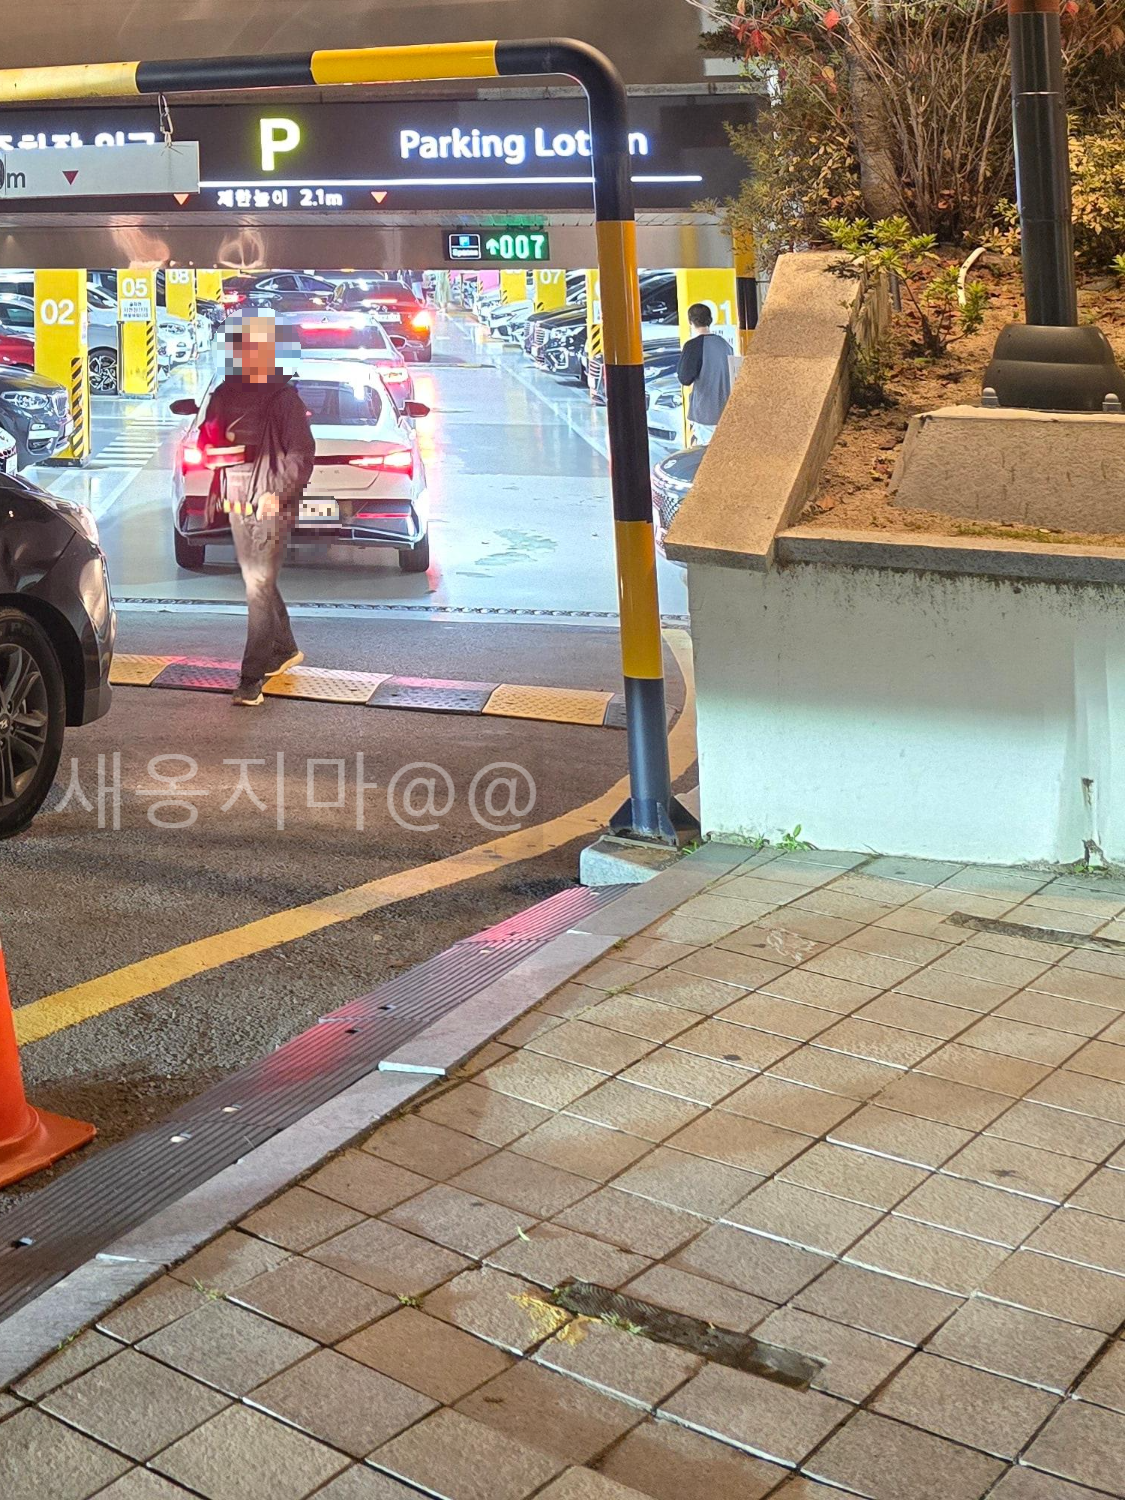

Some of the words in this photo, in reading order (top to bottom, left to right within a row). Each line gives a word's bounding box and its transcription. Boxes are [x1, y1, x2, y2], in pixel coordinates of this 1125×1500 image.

[259, 116, 302, 172] P
[399, 127, 526, 165] Parking
[535, 127, 594, 159] Lot
[299, 188, 344, 207] 2.1m
[499, 234, 545, 259] 007
[121, 276, 148, 298] 05
[539, 269, 561, 285] 07
[40, 298, 75, 326] 02
